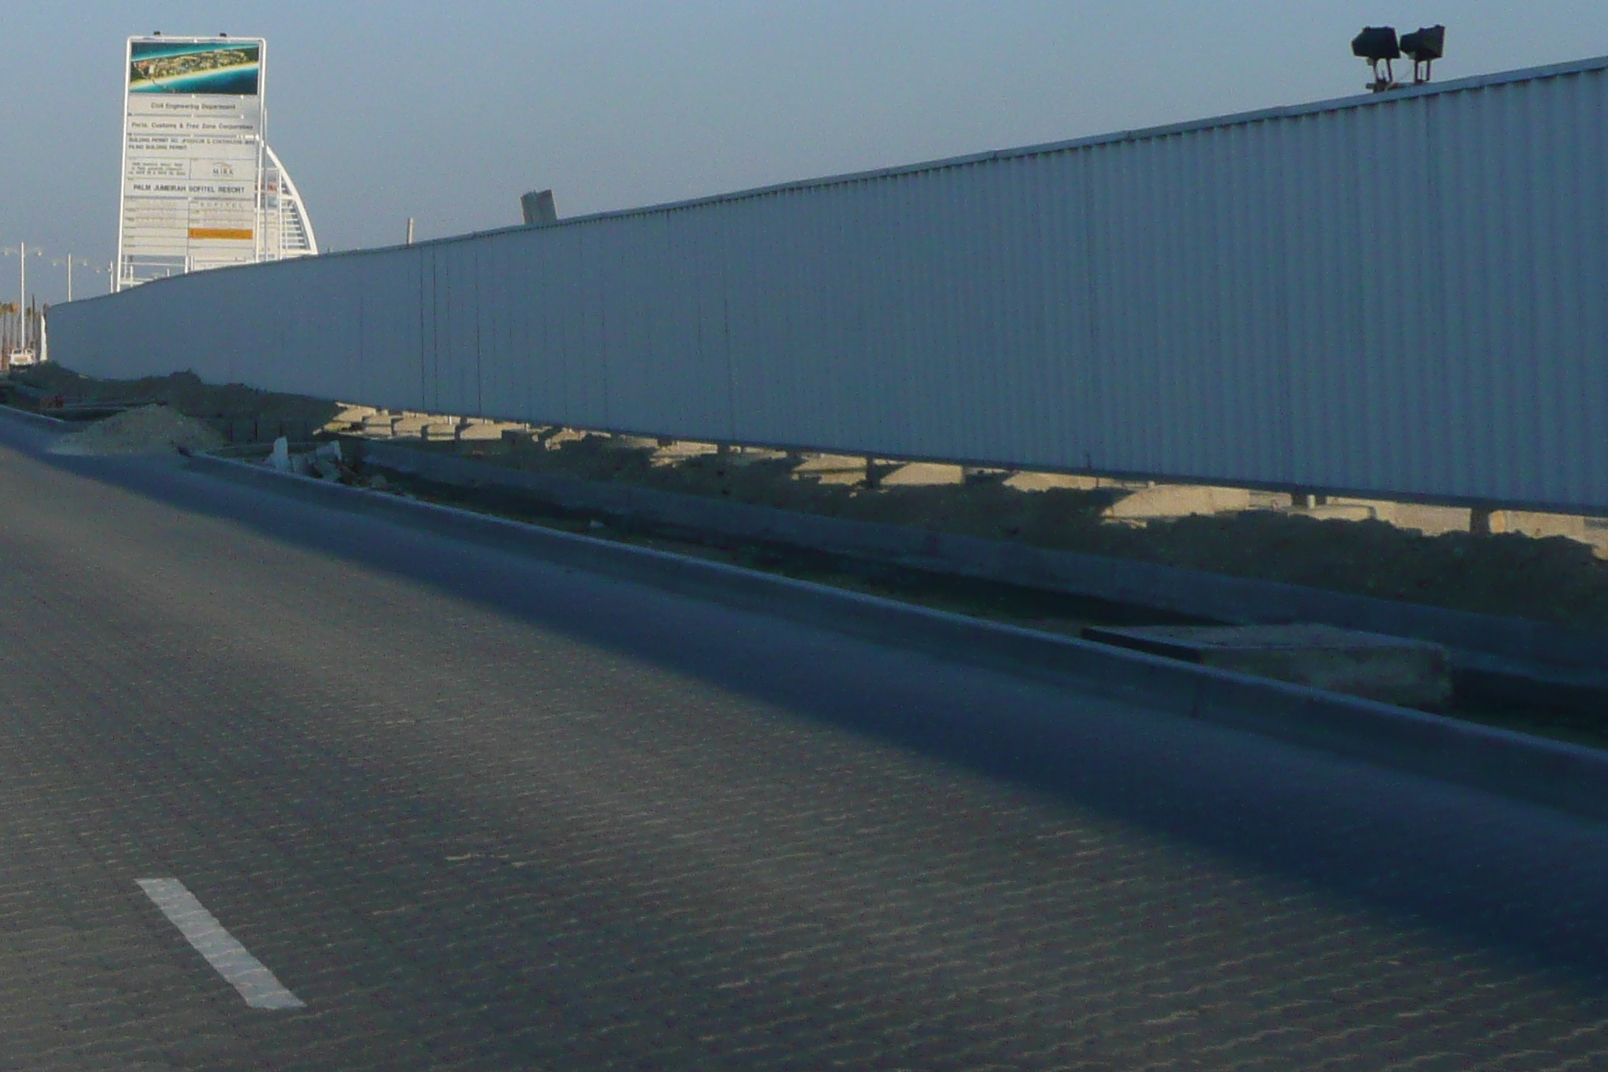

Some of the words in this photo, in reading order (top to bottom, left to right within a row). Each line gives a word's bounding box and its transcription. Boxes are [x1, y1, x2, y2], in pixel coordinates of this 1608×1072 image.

[165, 102, 199, 110] Engineering
[153, 184, 186, 192] JUMEIRAH
[188, 185, 215, 193] SOFITEL
[217, 186, 245, 194] RESORT
